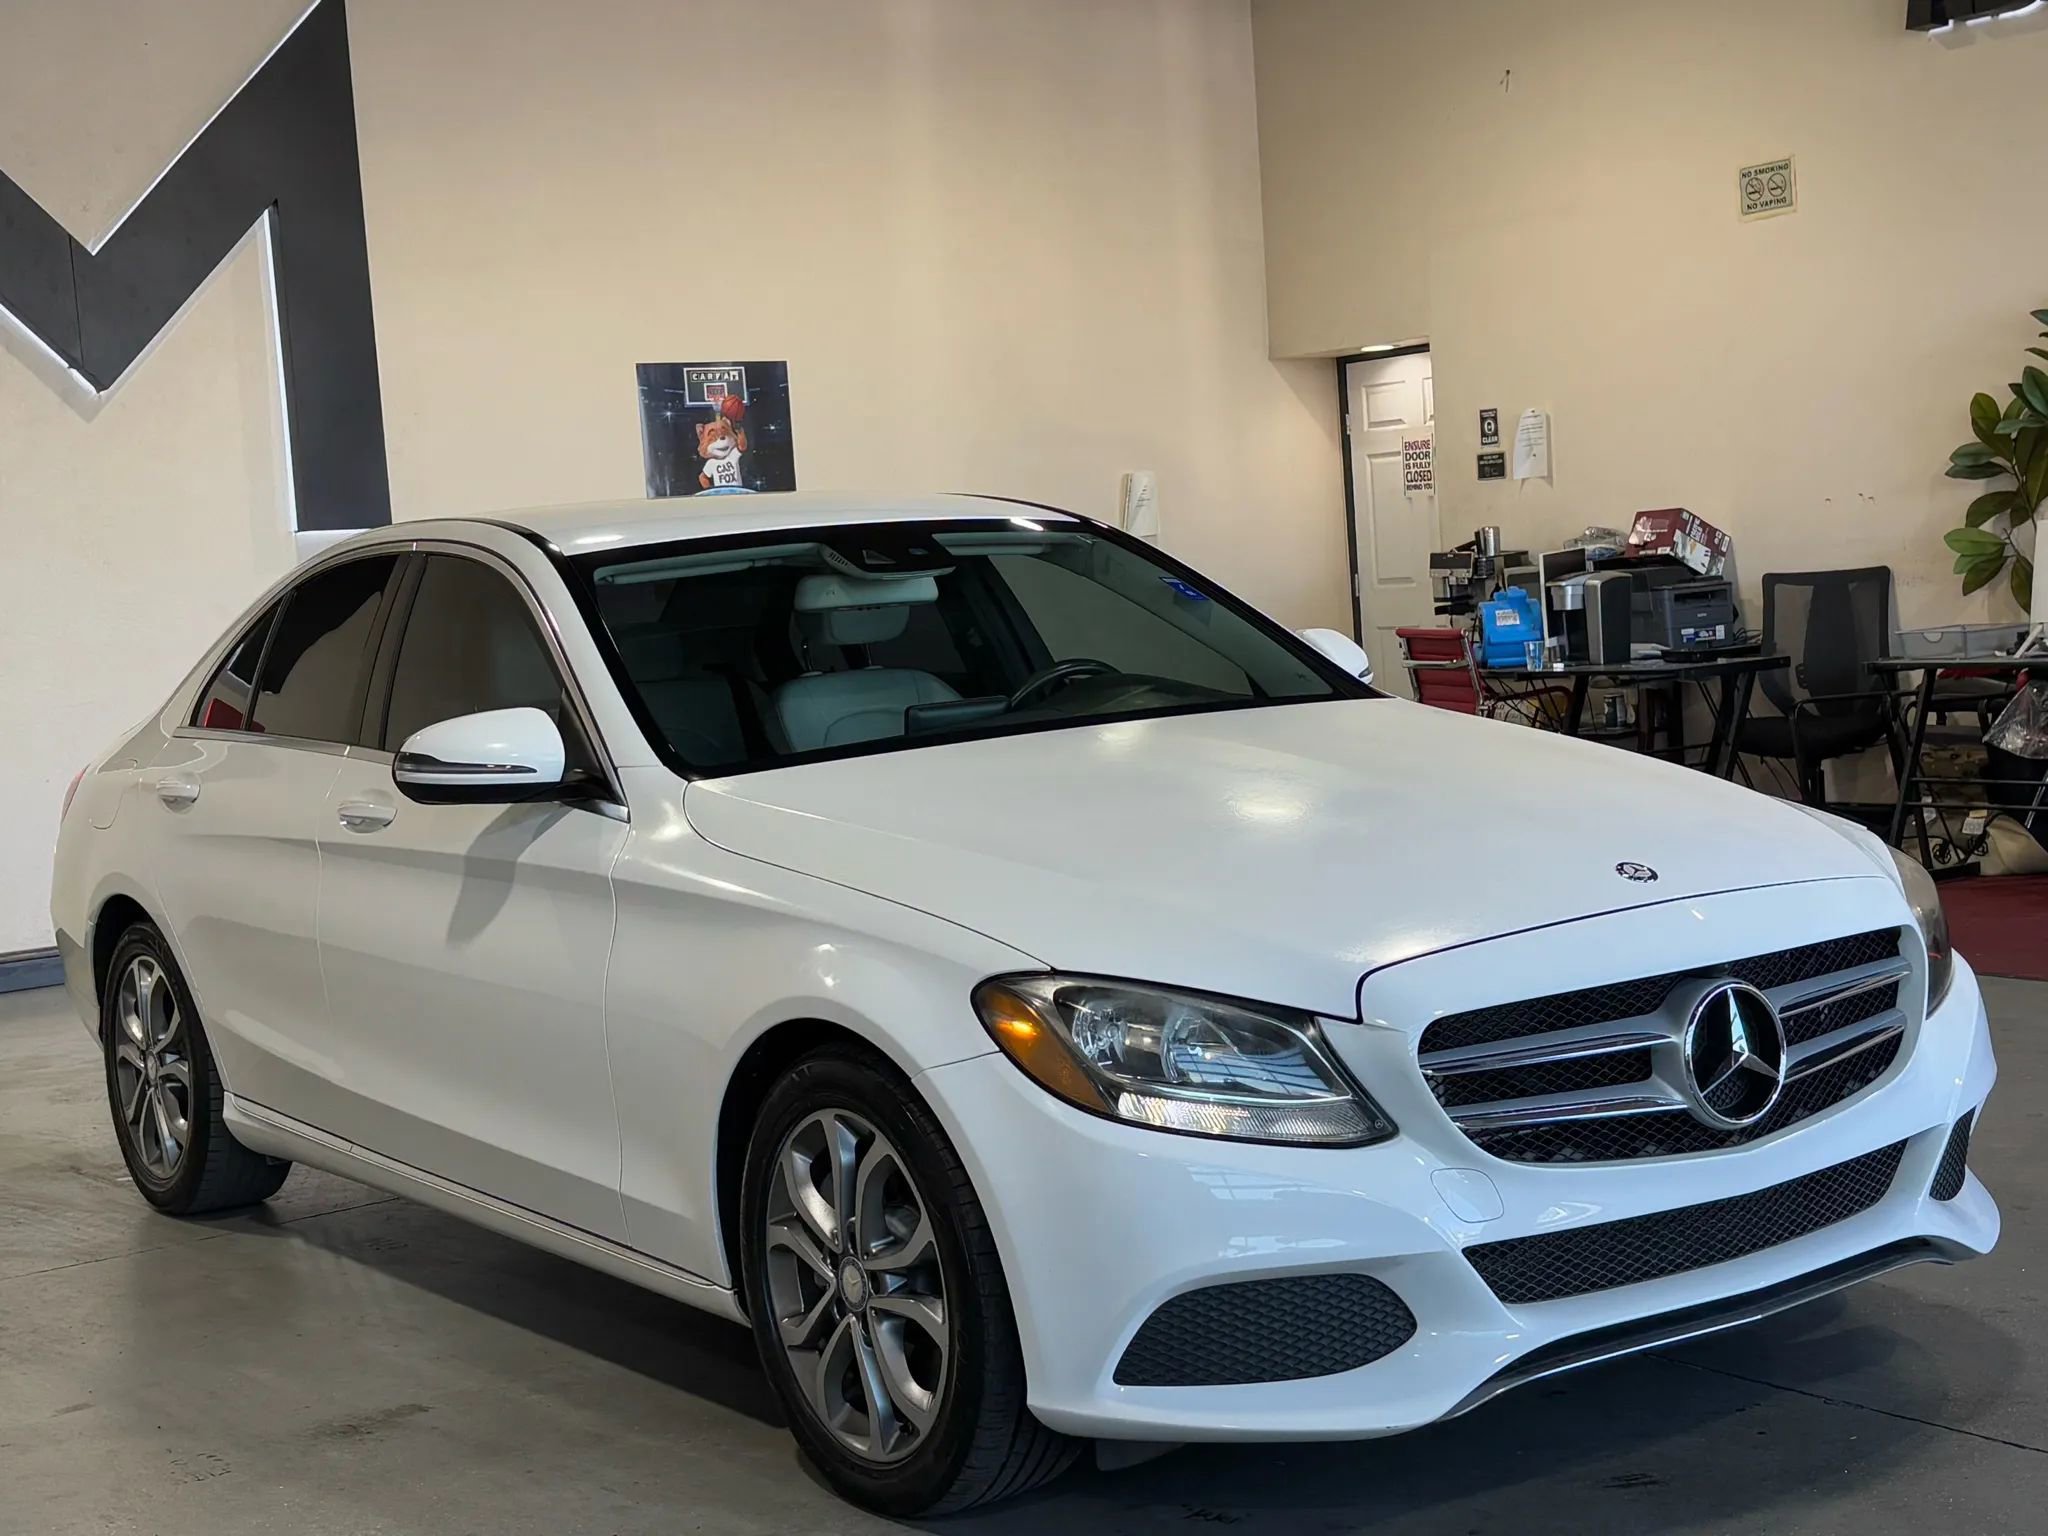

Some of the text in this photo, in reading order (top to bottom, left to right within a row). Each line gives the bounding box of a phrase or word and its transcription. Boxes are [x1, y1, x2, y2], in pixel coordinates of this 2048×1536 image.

[1742, 163, 1789, 179] NO SMOKING
[1759, 196, 1787, 208] VAPING
[1404, 440, 1431, 451] ENSURE
[1405, 451, 1431, 461] DOOR
[716, 461, 735, 474] CAR
[1412, 461, 1431, 469] FULLY
[718, 472, 737, 484] FOX
[1406, 470, 1432, 483] CLOSED
